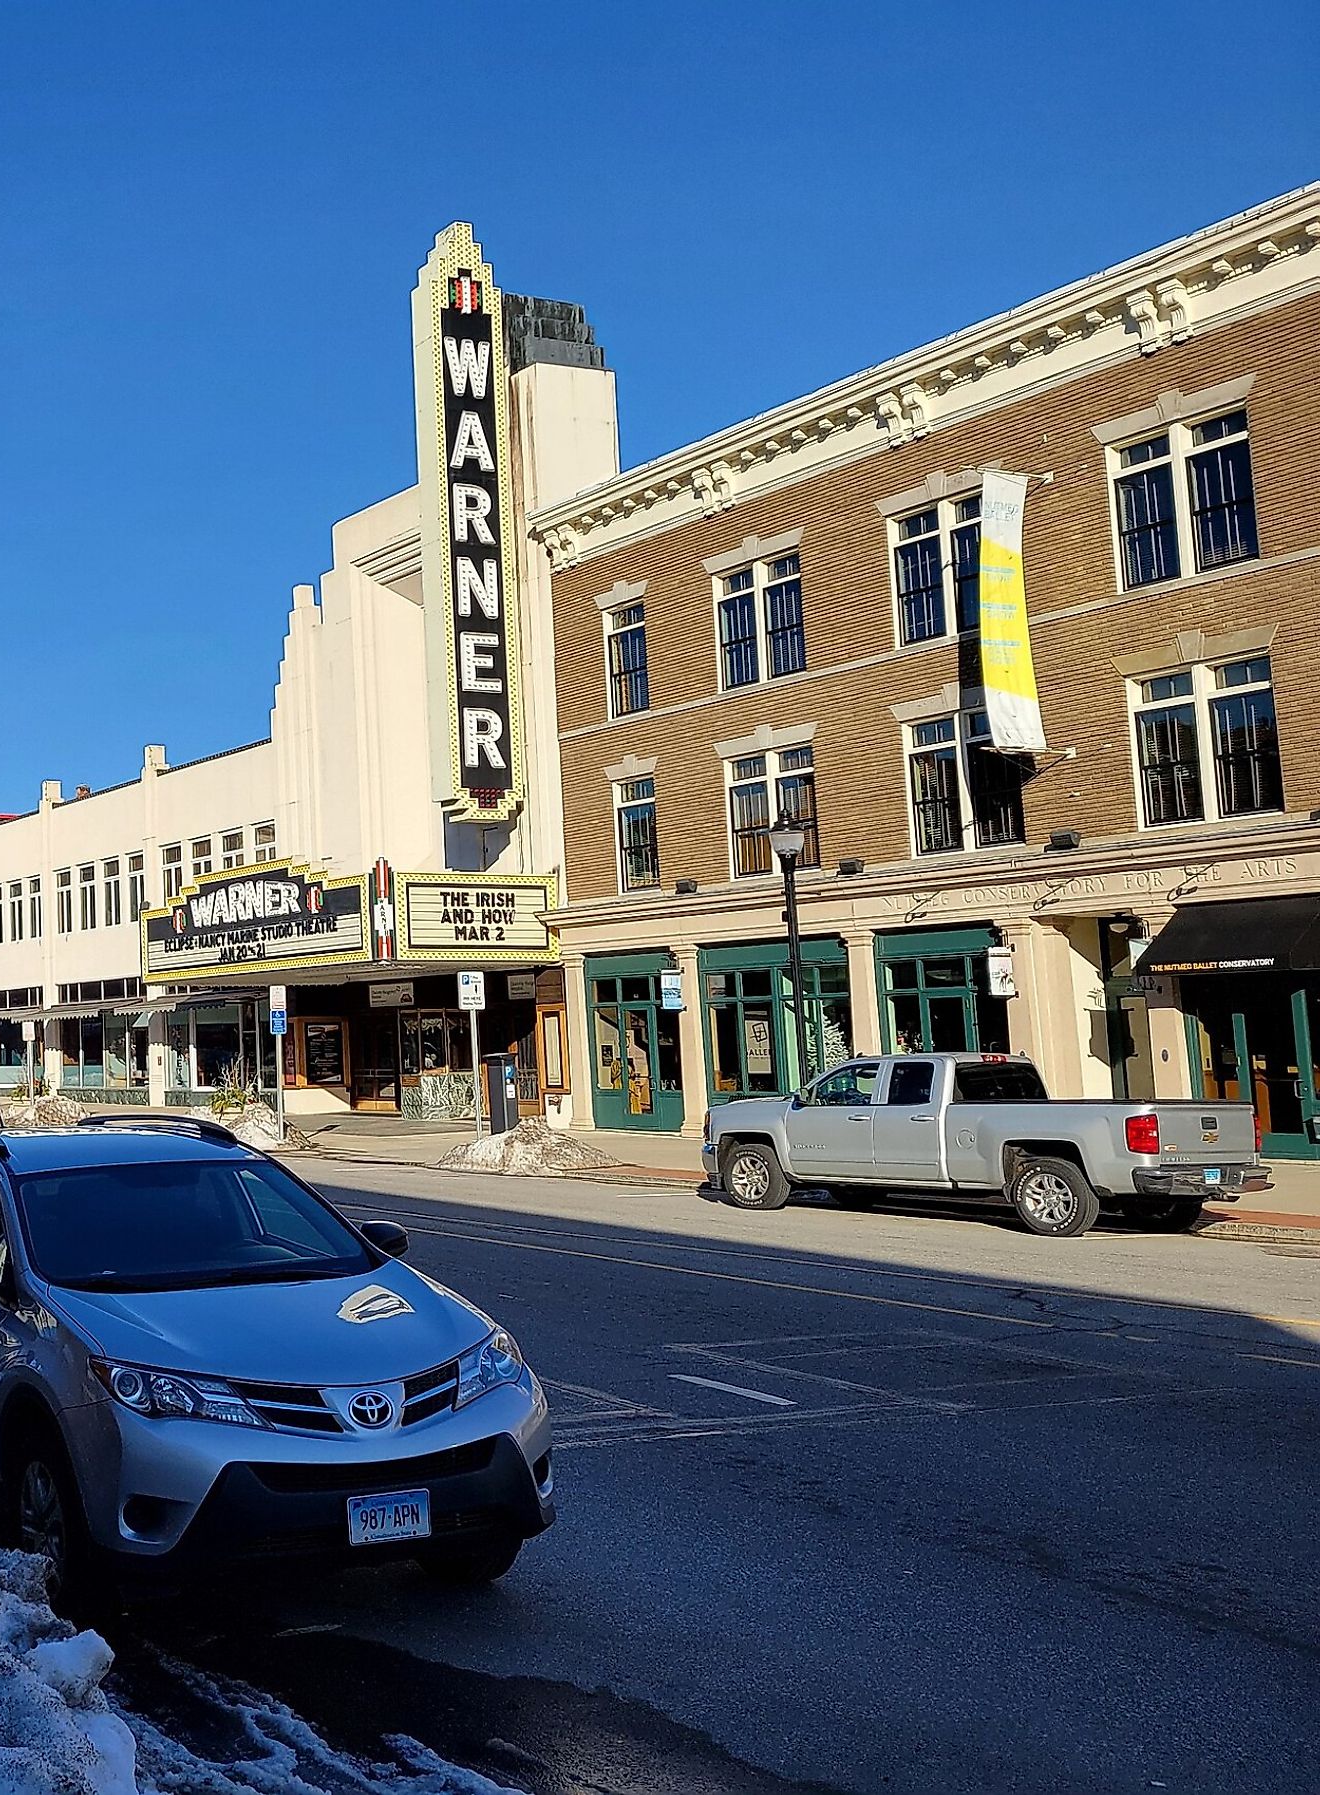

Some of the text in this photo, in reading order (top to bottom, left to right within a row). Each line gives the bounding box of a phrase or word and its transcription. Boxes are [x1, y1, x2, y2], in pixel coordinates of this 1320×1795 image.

[442, 335, 507, 770] WARNER
[961, 875, 1108, 904] CONSERVATORY
[1123, 871, 1165, 889] FOR
[1178, 864, 1223, 884] THE
[1240, 856, 1298, 880] ARTS
[189, 880, 302, 928] WARNER
[439, 891, 516, 909] THE IRISH
[440, 909, 516, 925] AND HOW
[260, 922, 293, 942] STUDIO
[295, 916, 338, 938] THEATRE
[454, 926, 506, 942] MAR 2
[236, 944, 248, 960] 20
[1149, 957, 1275, 972] THE NUTMEG BALLET CONSERVATORY
